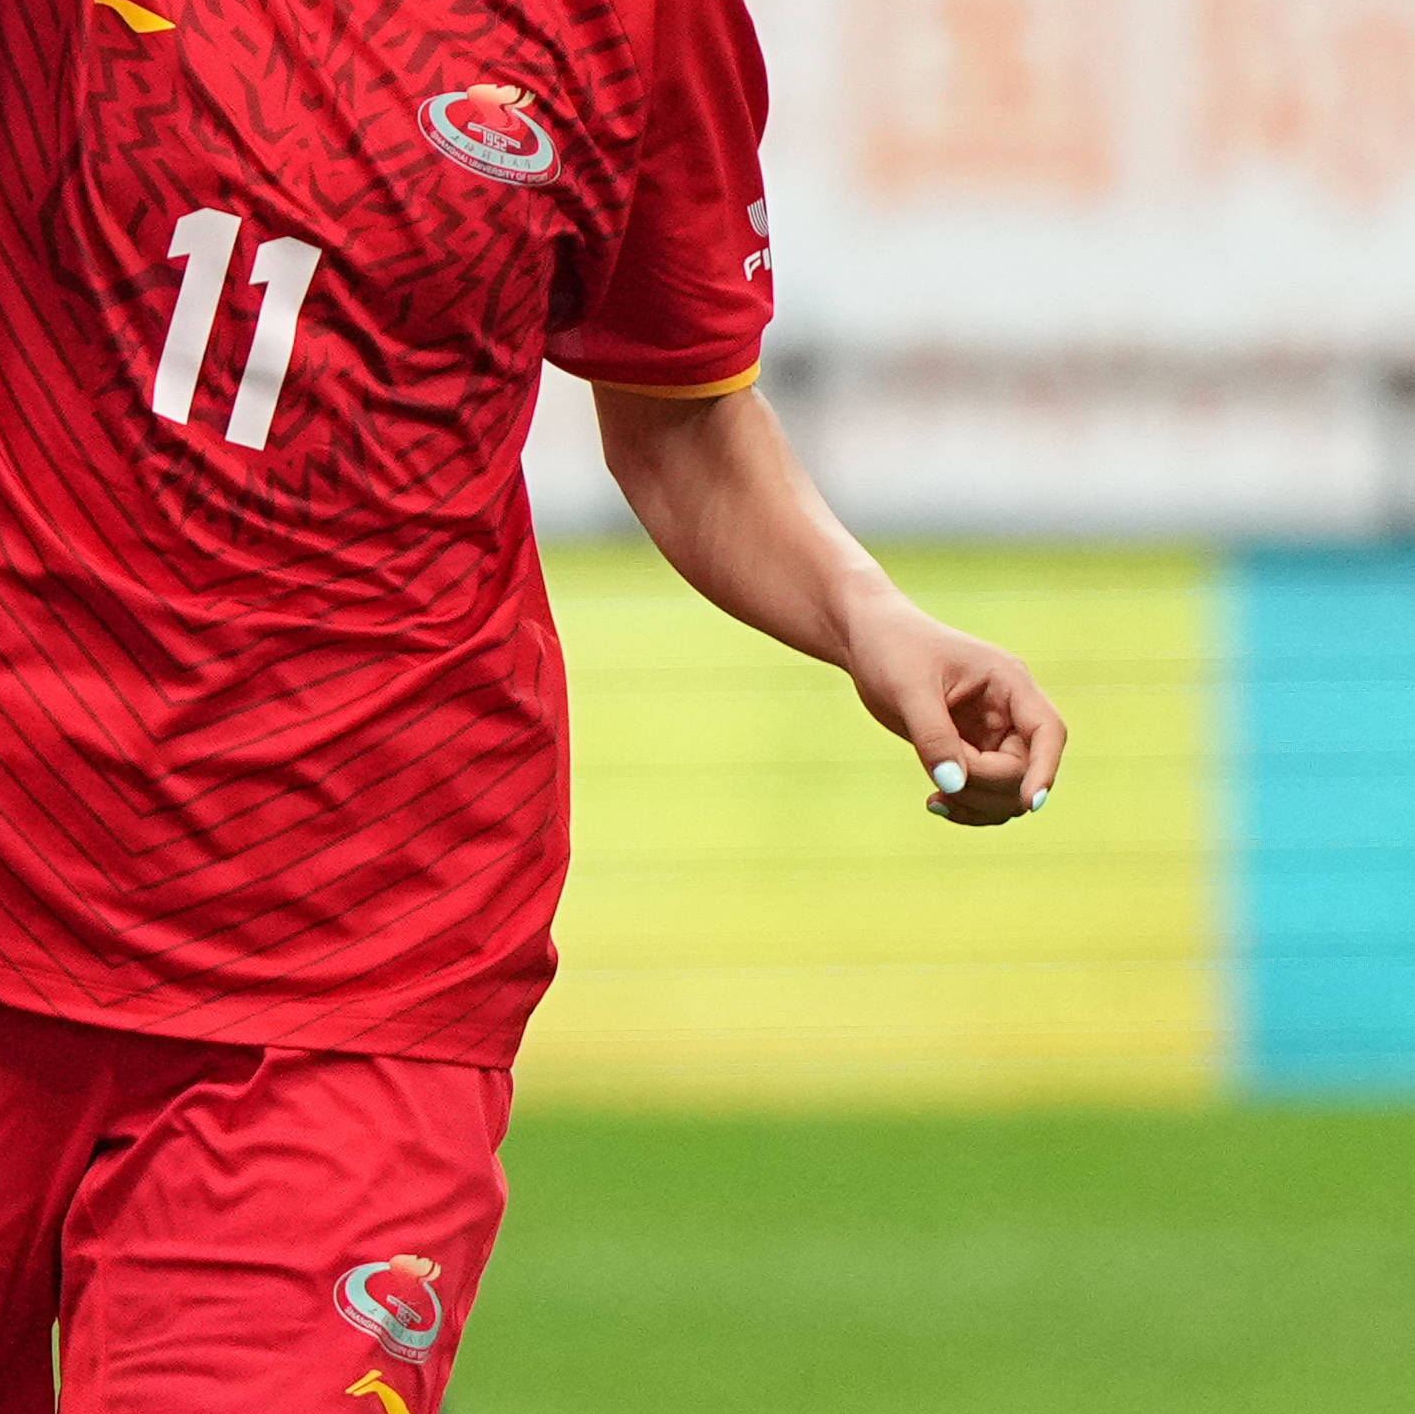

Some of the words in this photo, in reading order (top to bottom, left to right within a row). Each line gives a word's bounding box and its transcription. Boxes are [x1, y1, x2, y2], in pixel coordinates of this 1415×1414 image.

[429, 130, 469, 164] SHANGHAI
[468, 158, 516, 180] UNIVERSITY
[515, 171, 528, 182] OF
[151, 206, 323, 452] 11
